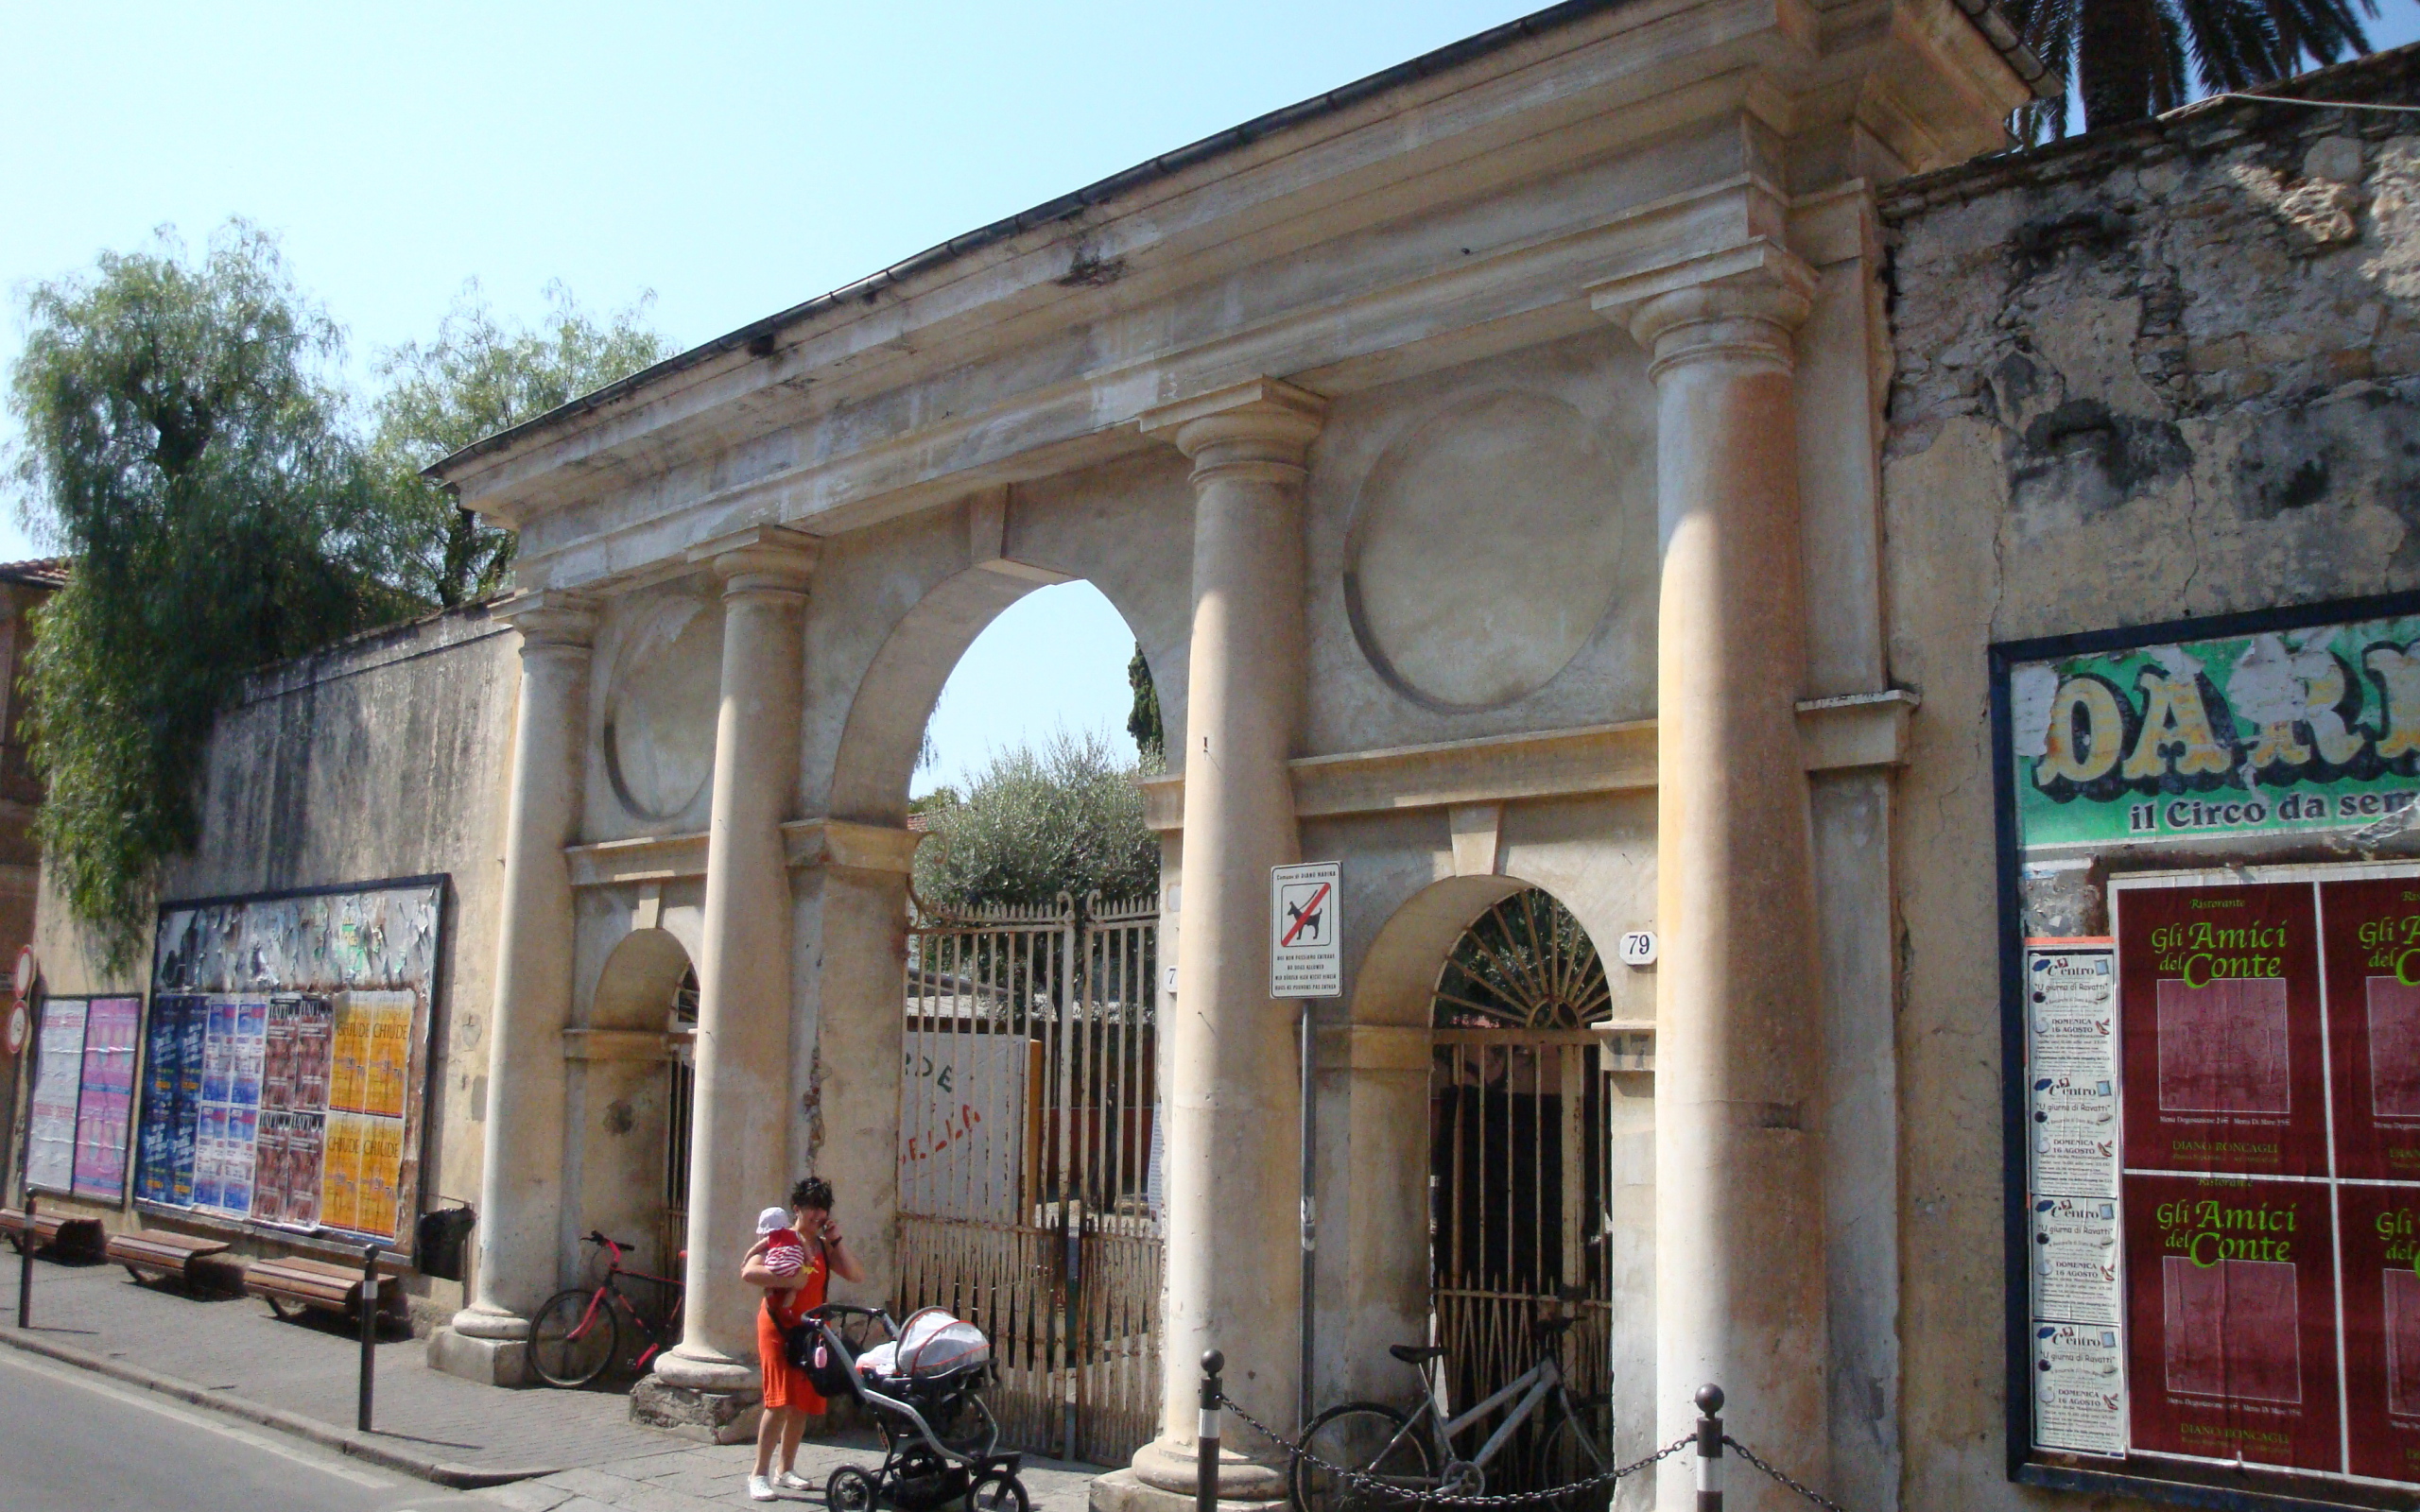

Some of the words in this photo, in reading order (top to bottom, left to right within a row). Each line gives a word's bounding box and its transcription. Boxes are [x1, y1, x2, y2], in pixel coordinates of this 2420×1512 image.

[2132, 804, 2155, 830] il
[2167, 801, 2267, 828] Circo
[2279, 793, 2325, 820] da
[2189, 899, 2246, 909] Ristorante
[2152, 922, 2184, 954] Gli
[2188, 919, 2288, 950] Amici
[2359, 917, 2394, 950] Gli
[1629, 935, 1651, 955] 79
[2368, 947, 2398, 968] del
[2047, 964, 2095, 977] Centro
[2159, 952, 2187, 971] del
[2184, 953, 2281, 988] Conte
[2046, 984, 2068, 992] giurna
[373, 1022, 408, 1040] CHIUDE
[2048, 1084, 2097, 1096] Centro
[2048, 1104, 2070, 1112] giurna
[327, 1136, 359, 1154] CHIUDE
[364, 1140, 400, 1159] CHIUDE
[2172, 1141, 2212, 1151] DIANO
[2051, 1206, 2100, 1219] Centro
[2156, 1199, 2190, 1229] Gli
[2195, 1200, 2297, 1231] Amici
[2049, 1226, 2072, 1234] giurna
[2376, 1208, 2413, 1241] Gli
[2165, 1229, 2193, 1248] del
[2190, 1231, 2290, 1268] Conte
[2385, 1239, 2418, 1260] del
[2051, 1332, 2100, 1347] Centro
[2050, 1352, 2073, 1362] giurna
[2076, 1352, 2083, 1361] di
[2058, 1388, 2100, 1398] DOMENICA
[2068, 1398, 2100, 1407] AGOSTO
